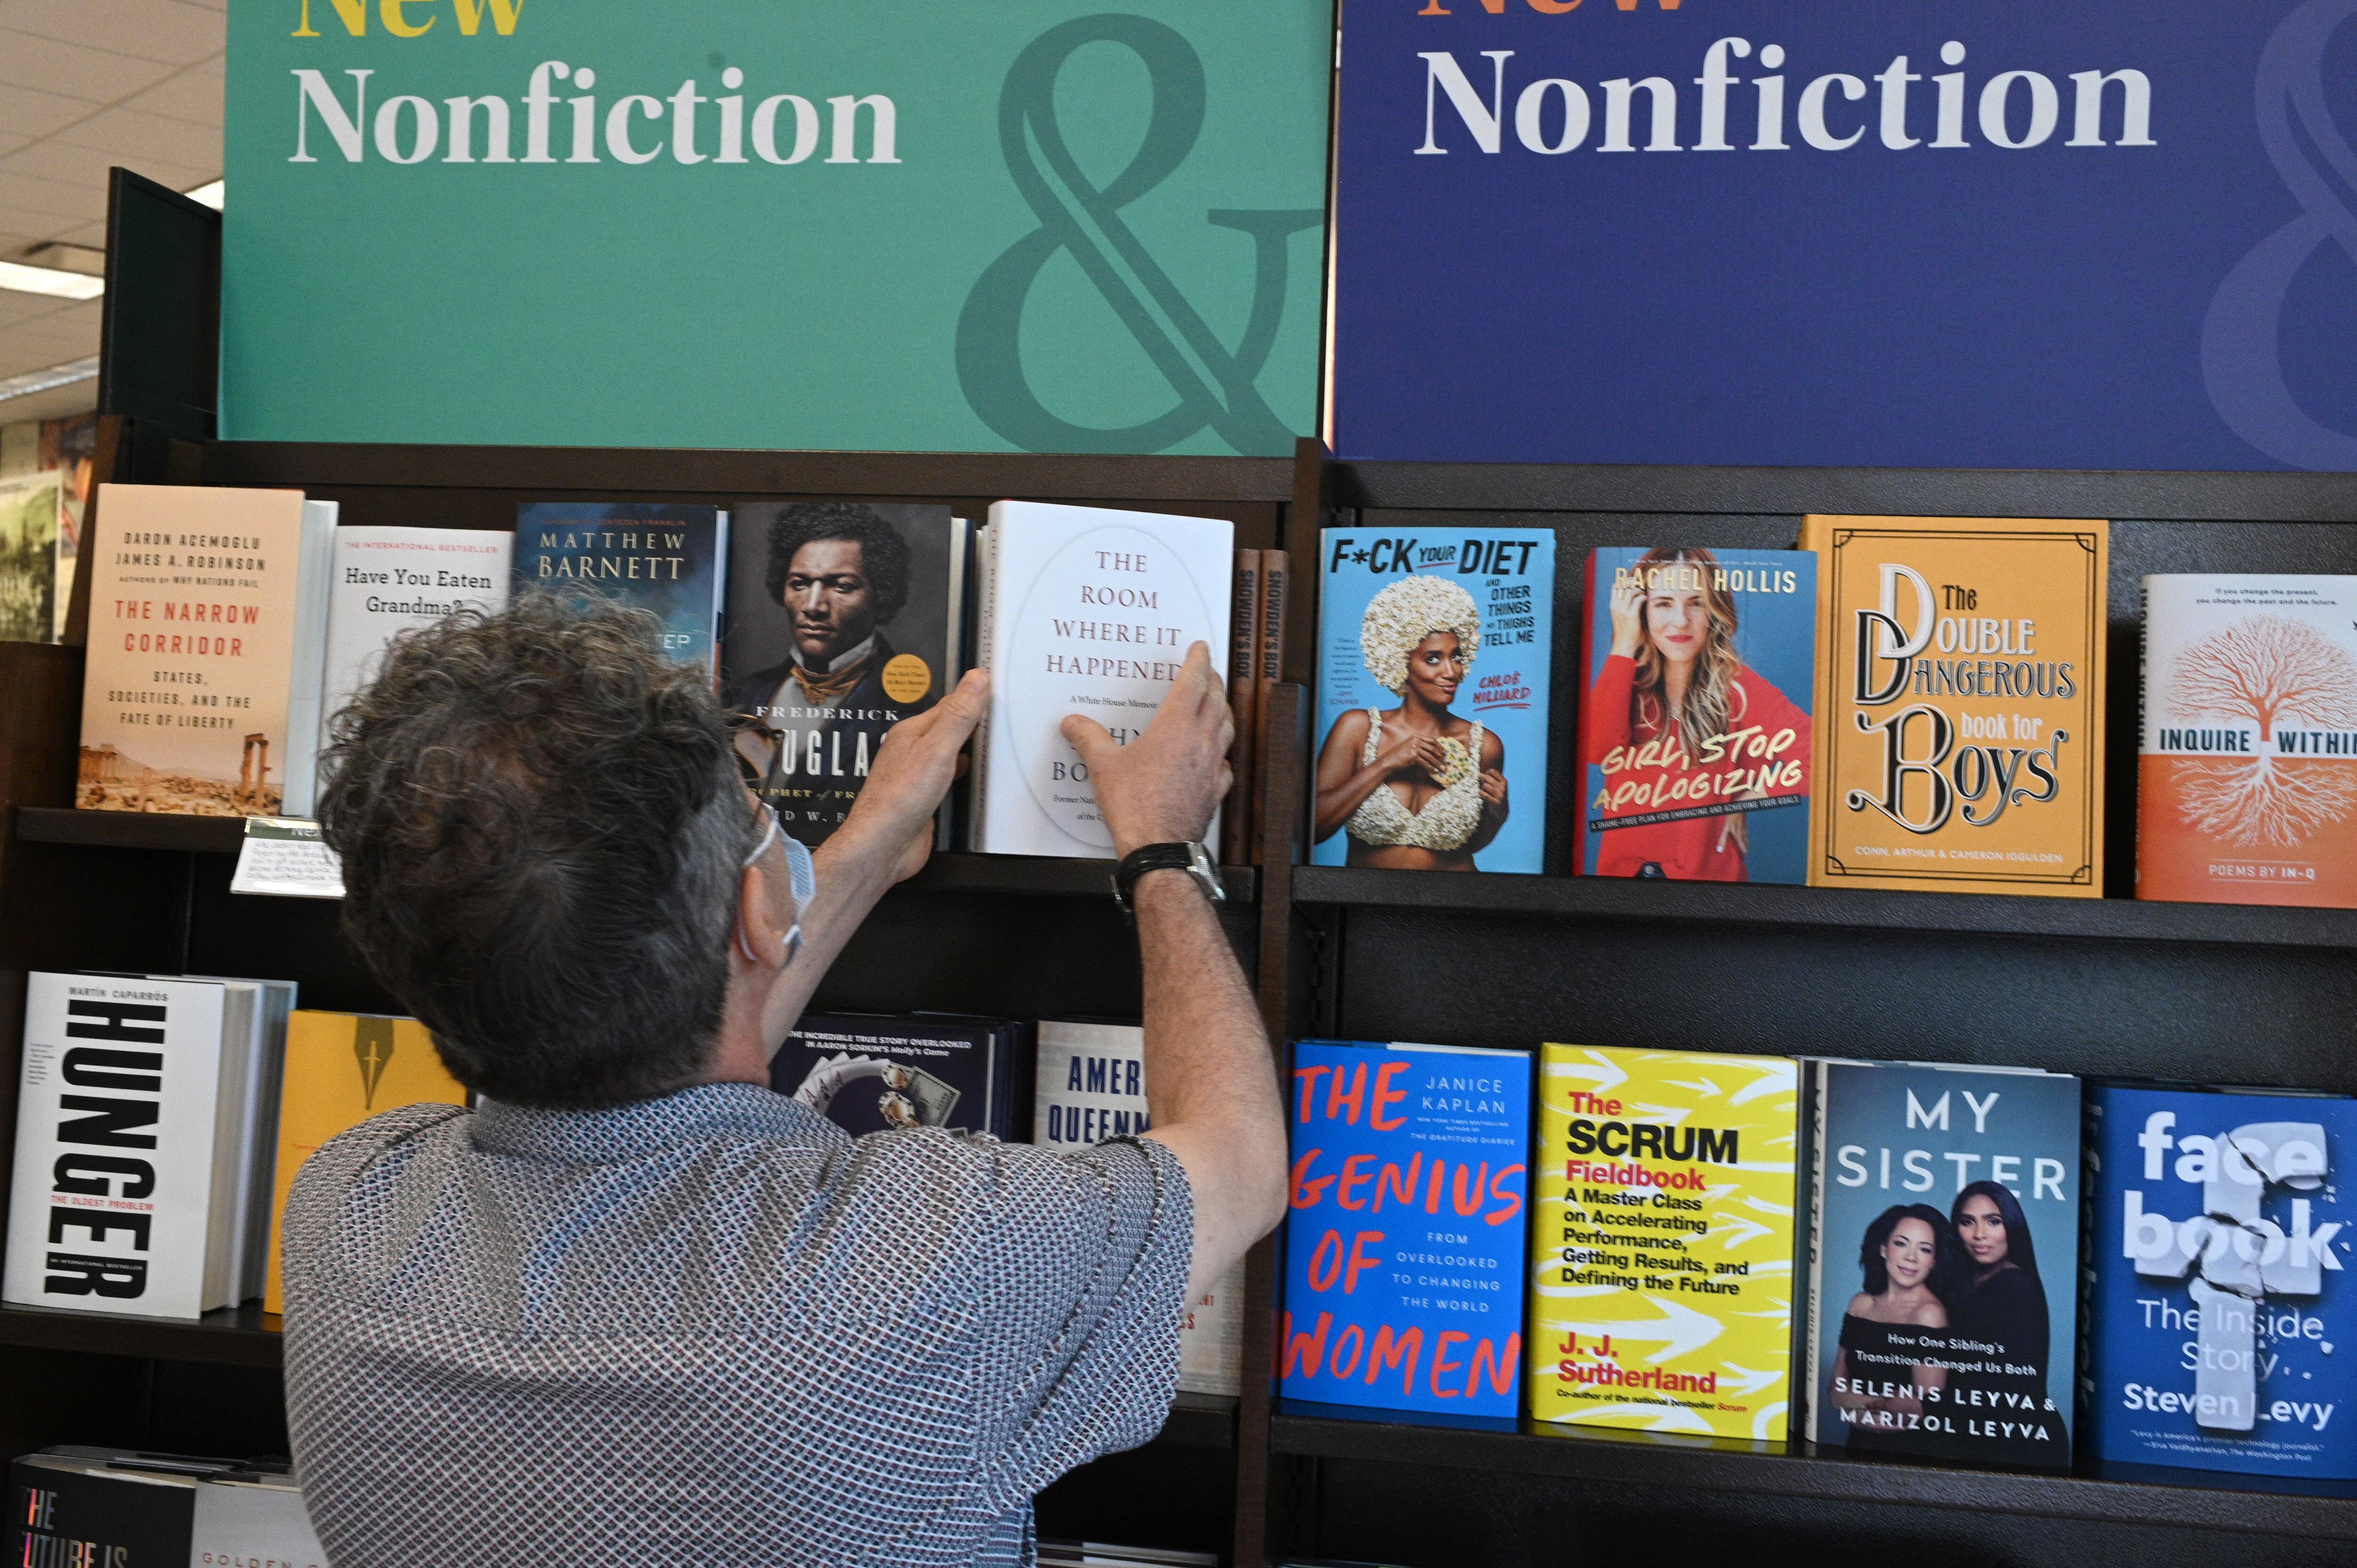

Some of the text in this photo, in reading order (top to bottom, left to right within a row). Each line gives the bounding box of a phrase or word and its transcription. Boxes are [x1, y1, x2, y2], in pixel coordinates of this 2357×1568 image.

[1413, 36, 2159, 155] Nonfiction
[288, 60, 903, 165] Nonfiction
[124, 533, 260, 549] DARON ACEMOGLU
[540, 532, 684, 550] MATTHEW
[115, 553, 265, 571] JAMES A. ROBINSON
[539, 556, 684, 580] BARNETT
[1095, 550, 1147, 573] THE
[1418, 546, 1456, 562] YOUR
[1458, 539, 1538, 575] DIET
[345, 567, 493, 589] Have You Eaten
[1615, 567, 1797, 594] RACHEL HOLLIS
[1080, 585, 1159, 609] ROOM
[1491, 585, 1531, 600] OTHER
[1942, 585, 1977, 610] The
[115, 600, 260, 624] THE NARROW
[1487, 600, 1531, 616] THINGS
[1053, 619, 1181, 647] WHERE IT
[1236, 569, 1254, 680] SNOWDEN'S BOX
[1263, 570, 1282, 680] SNOWDEN'S BOX
[1497, 616, 1535, 630] THIGHS
[124, 633, 243, 656] CORRIDOR
[1484, 630, 1535, 647] TELL ME
[154, 671, 208, 685] STATES,
[108, 690, 251, 708] SOCIETIES, AND THE
[120, 713, 235, 729] FATE OF LIBERTY
[756, 706, 899, 721] FREDERICK
[1961, 712, 2044, 740] book for
[1600, 725, 1797, 776] GIRL, STOP
[2159, 729, 2250, 752] INQUIRE
[1845, 703, 2069, 835] Boys
[1592, 759, 1804, 812] APOLOGIZING
[1893, 848, 1936, 858] ARTHUR
[1938, 850, 1947, 858] &
[1949, 849, 2003, 860] CAMERON
[2006, 852, 2063, 863] IGGULDEN
[2209, 865, 2316, 881] POEMS BY IN-Q
[804, 1032, 972, 1049] INCREDIBLE TRUE STORY OVERLOOKED
[816, 1041, 848, 1050] AARON
[848, 1043, 890, 1053] SORKIN'S
[890, 1046, 922, 1056] Molly's
[923, 1048, 950, 1057] Game
[1293, 1061, 1412, 1132] THE
[1426, 1076, 1504, 1094] JANICE
[1422, 1096, 1506, 1115] KAPLAN
[1568, 1091, 1623, 1116] The
[1906, 1087, 2001, 1134] MY
[43, 999, 168, 1300] HUNGER
[1428, 1134, 1478, 1143] GRATITUDE
[1480, 1137, 1516, 1145] DIARIES
[1566, 1120, 1739, 1164] SCRUM
[2138, 1110, 2325, 1191] face
[1566, 1159, 1706, 1191] Fieldbook
[1835, 1144, 2068, 1202] SISTER
[1289, 1148, 1526, 1227] GENIUS
[1564, 1188, 1703, 1212] A Master Class
[51, 1194, 154, 1211] THE OLDEST PROBLEM
[1563, 1209, 1707, 1235] on Accelerating
[2123, 1190, 2344, 1272] book
[1427, 1231, 1469, 1245] FROM
[1563, 1227, 1688, 1253] Performance,
[1307, 1228, 1385, 1295] OF
[1395, 1251, 1498, 1270] OVERLOOKED
[1562, 1247, 1749, 1277] Getting Results, and
[1391, 1273, 1500, 1292] TO CHANGING
[1561, 1268, 1740, 1296] Defining the Future
[1401, 1296, 1490, 1314] THE WORLD
[2136, 1298, 2324, 1341] The Inside
[1280, 1310, 1522, 1399] WOMEN
[1558, 1331, 1618, 1359] J. J.
[1887, 1332, 2005, 1355] How One Sibling's
[1855, 1349, 2037, 1378] Transition Changed Us Both
[2180, 1341, 2280, 1383] Story
[1558, 1359, 1717, 1395] Sutherland
[1557, 1388, 1601, 1400] Co-author
[1615, 1394, 1630, 1403] the
[1632, 1396, 1668, 1406] national
[1718, 1402, 1748, 1412] Scrum
[1835, 1376, 2057, 1412] SELENIS LEYVA &
[2123, 1382, 2334, 1432] Steven Levy
[1839, 1406, 2051, 1442] MARIZOL LEYVA
